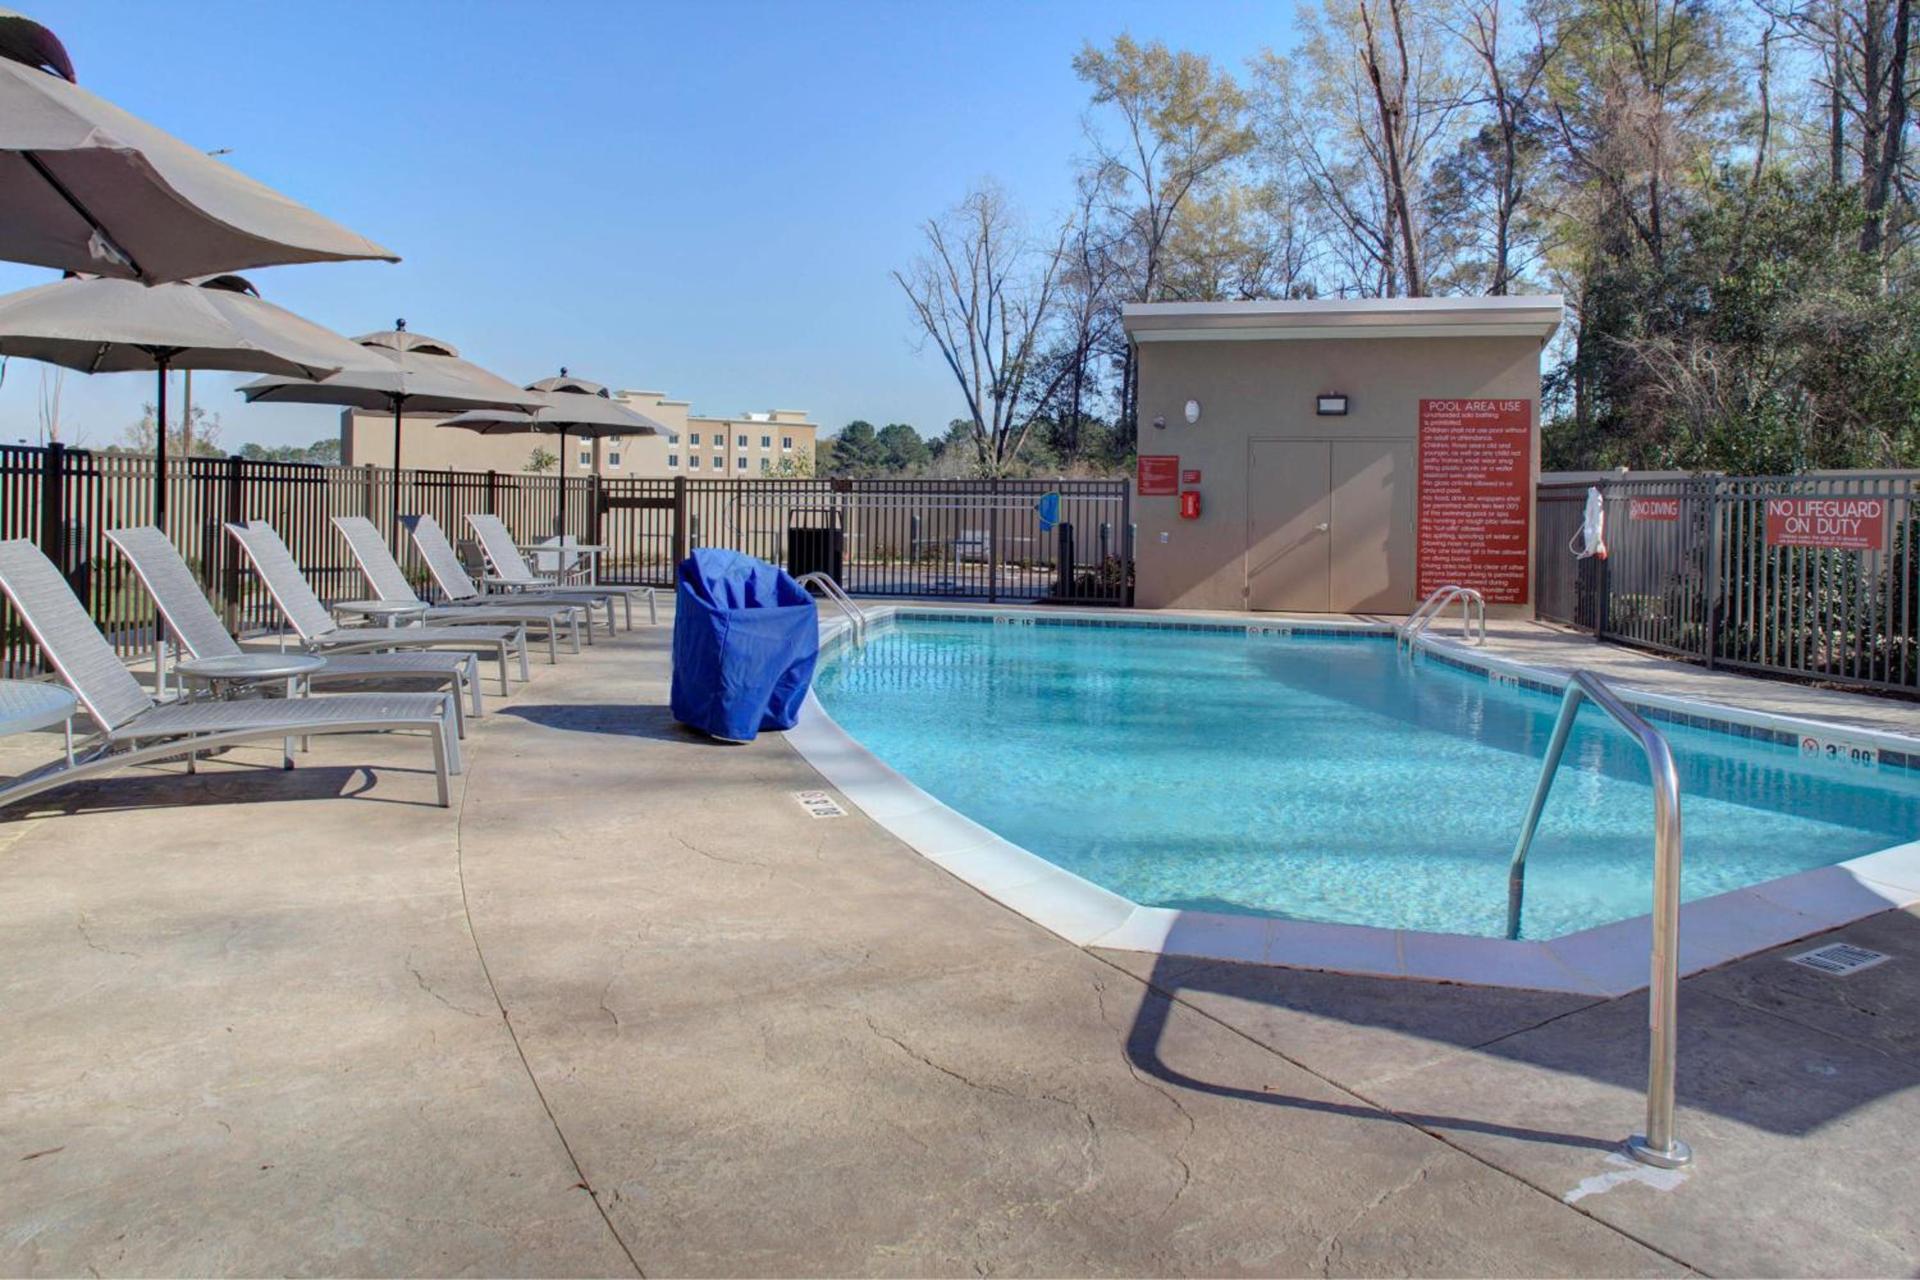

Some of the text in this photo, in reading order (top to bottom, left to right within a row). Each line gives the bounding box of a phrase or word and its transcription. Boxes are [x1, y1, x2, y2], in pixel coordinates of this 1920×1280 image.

[1429, 401, 1522, 412] POOL AREA USE
[1769, 500, 1880, 518] NO LIFEGUARD
[1784, 517, 1861, 535] ON DUTY
